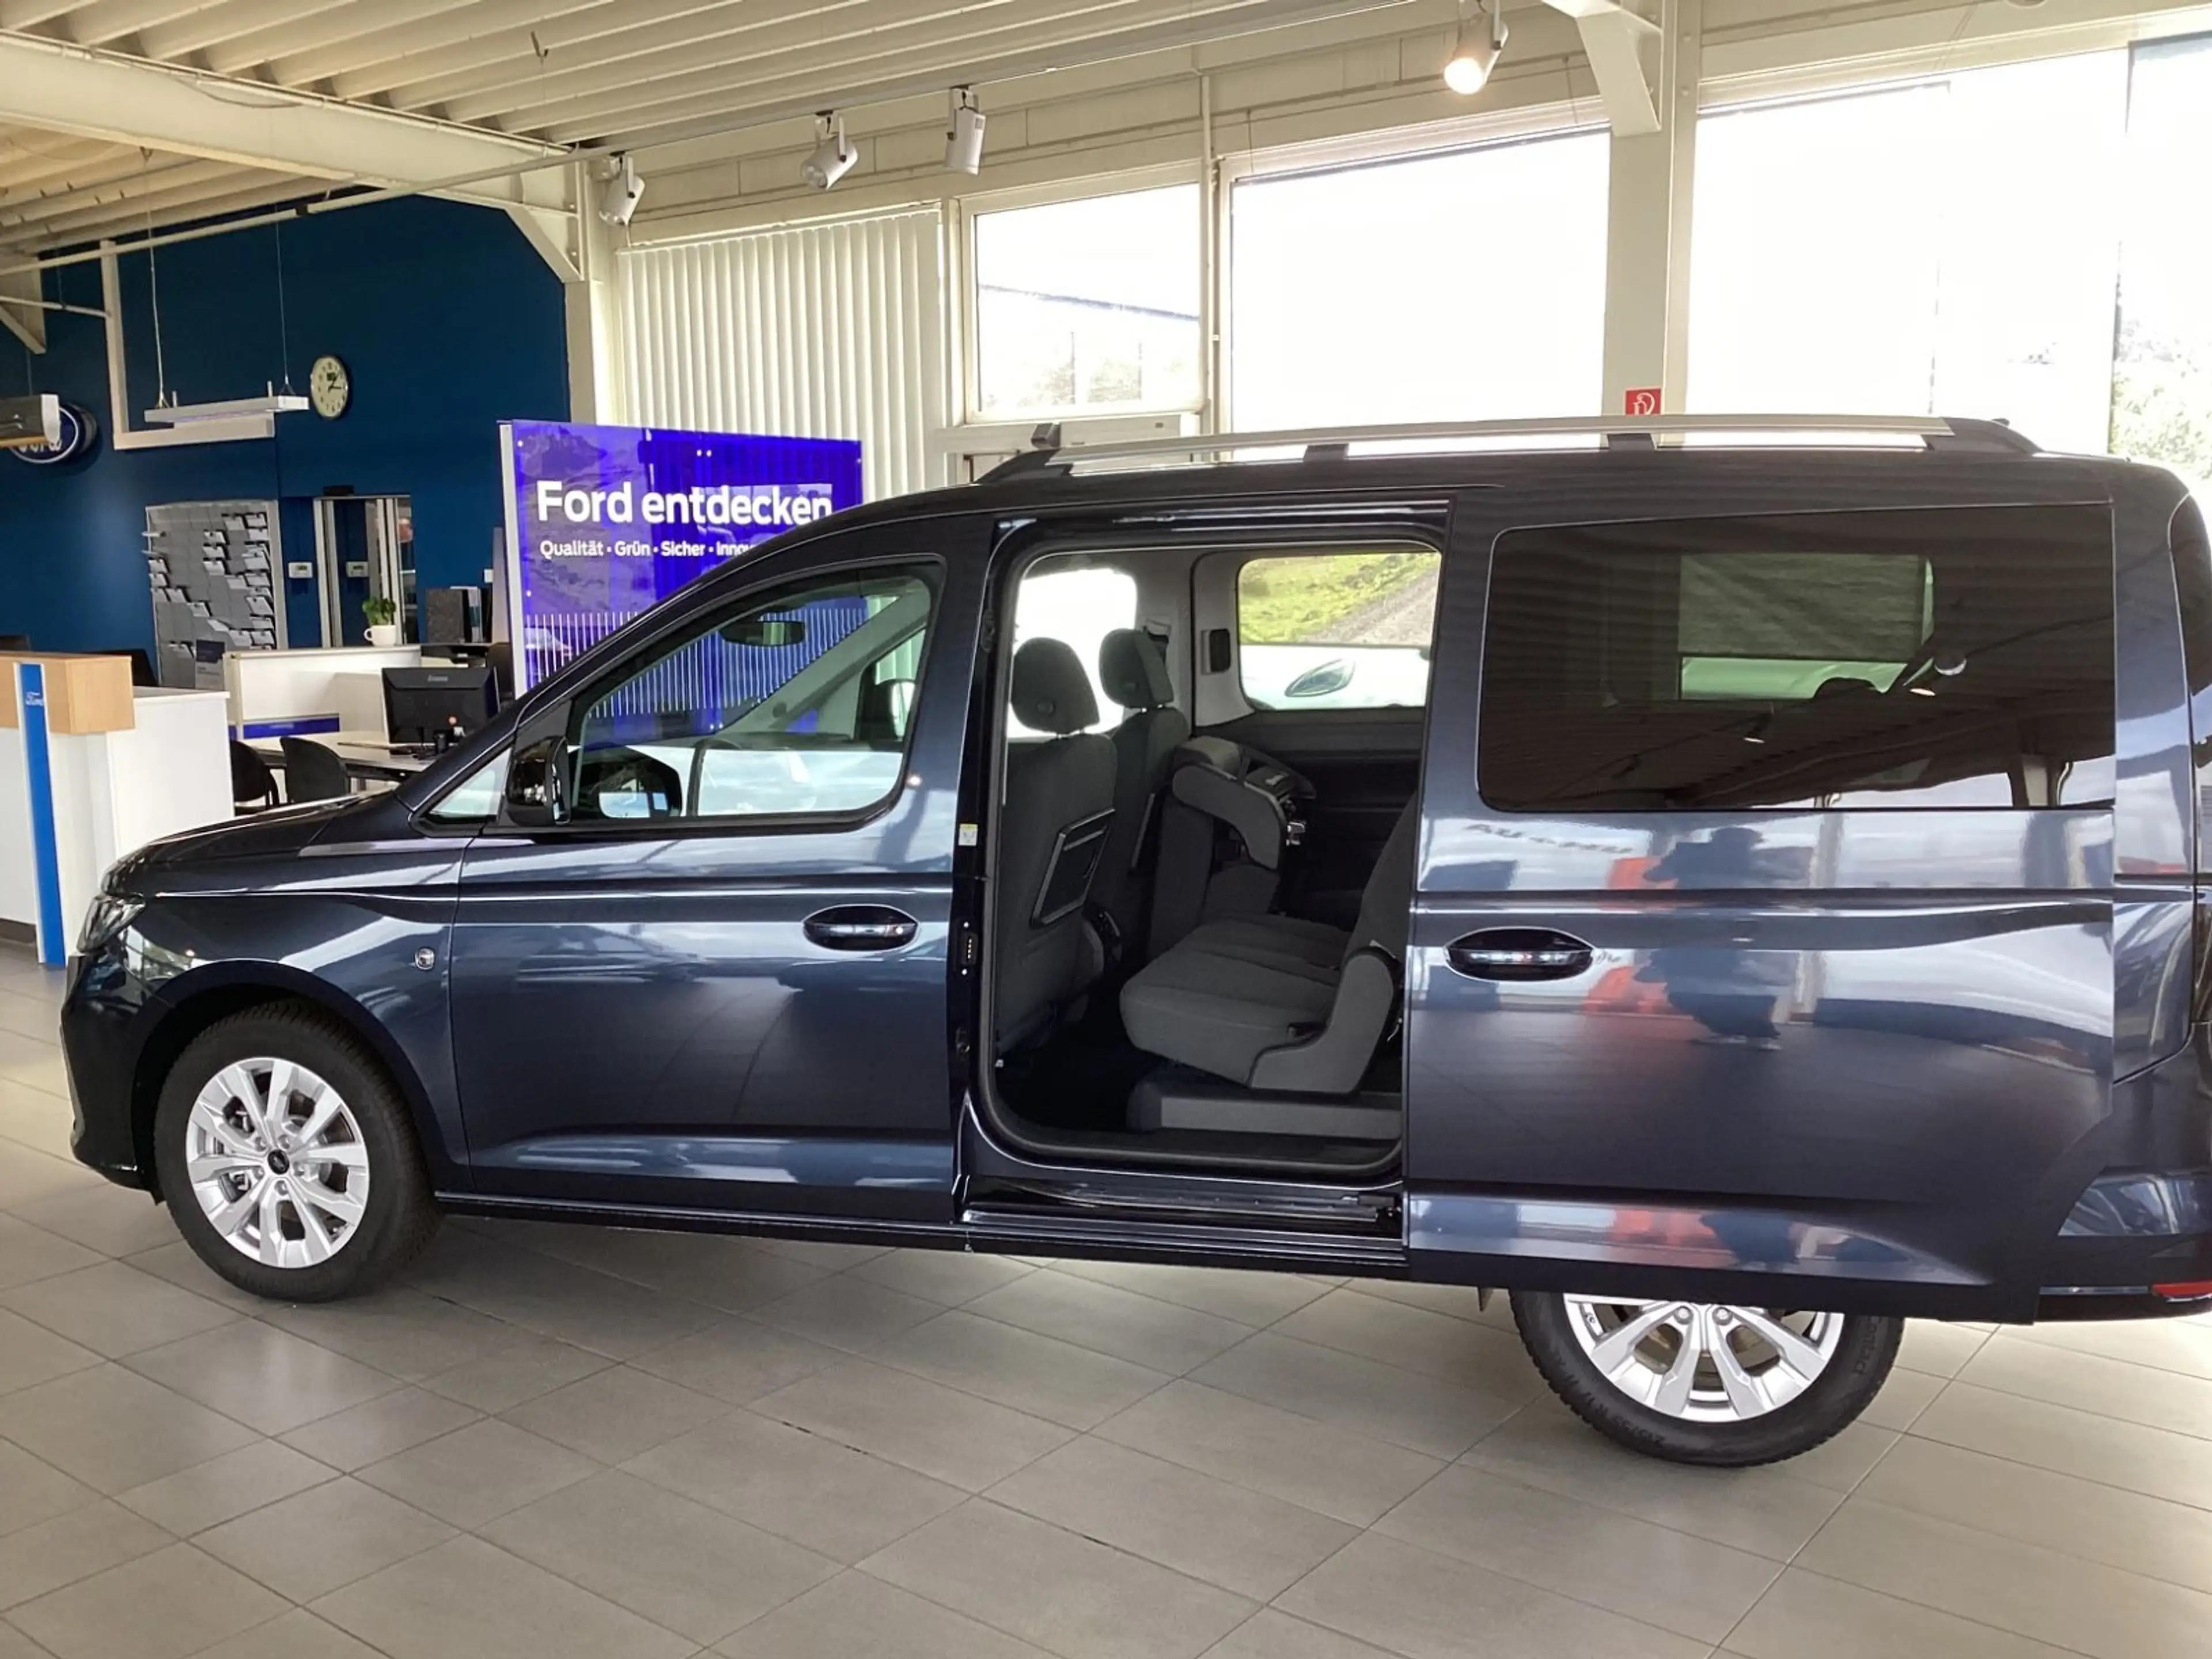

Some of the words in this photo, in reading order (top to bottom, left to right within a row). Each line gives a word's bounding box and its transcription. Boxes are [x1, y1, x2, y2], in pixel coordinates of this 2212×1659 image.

[536, 480, 633, 522] Ford
[641, 484, 832, 525] entdecken
[540, 540, 604, 559] Qualität
[615, 540, 650, 556] Grün
[661, 541, 706, 556] Sicher
